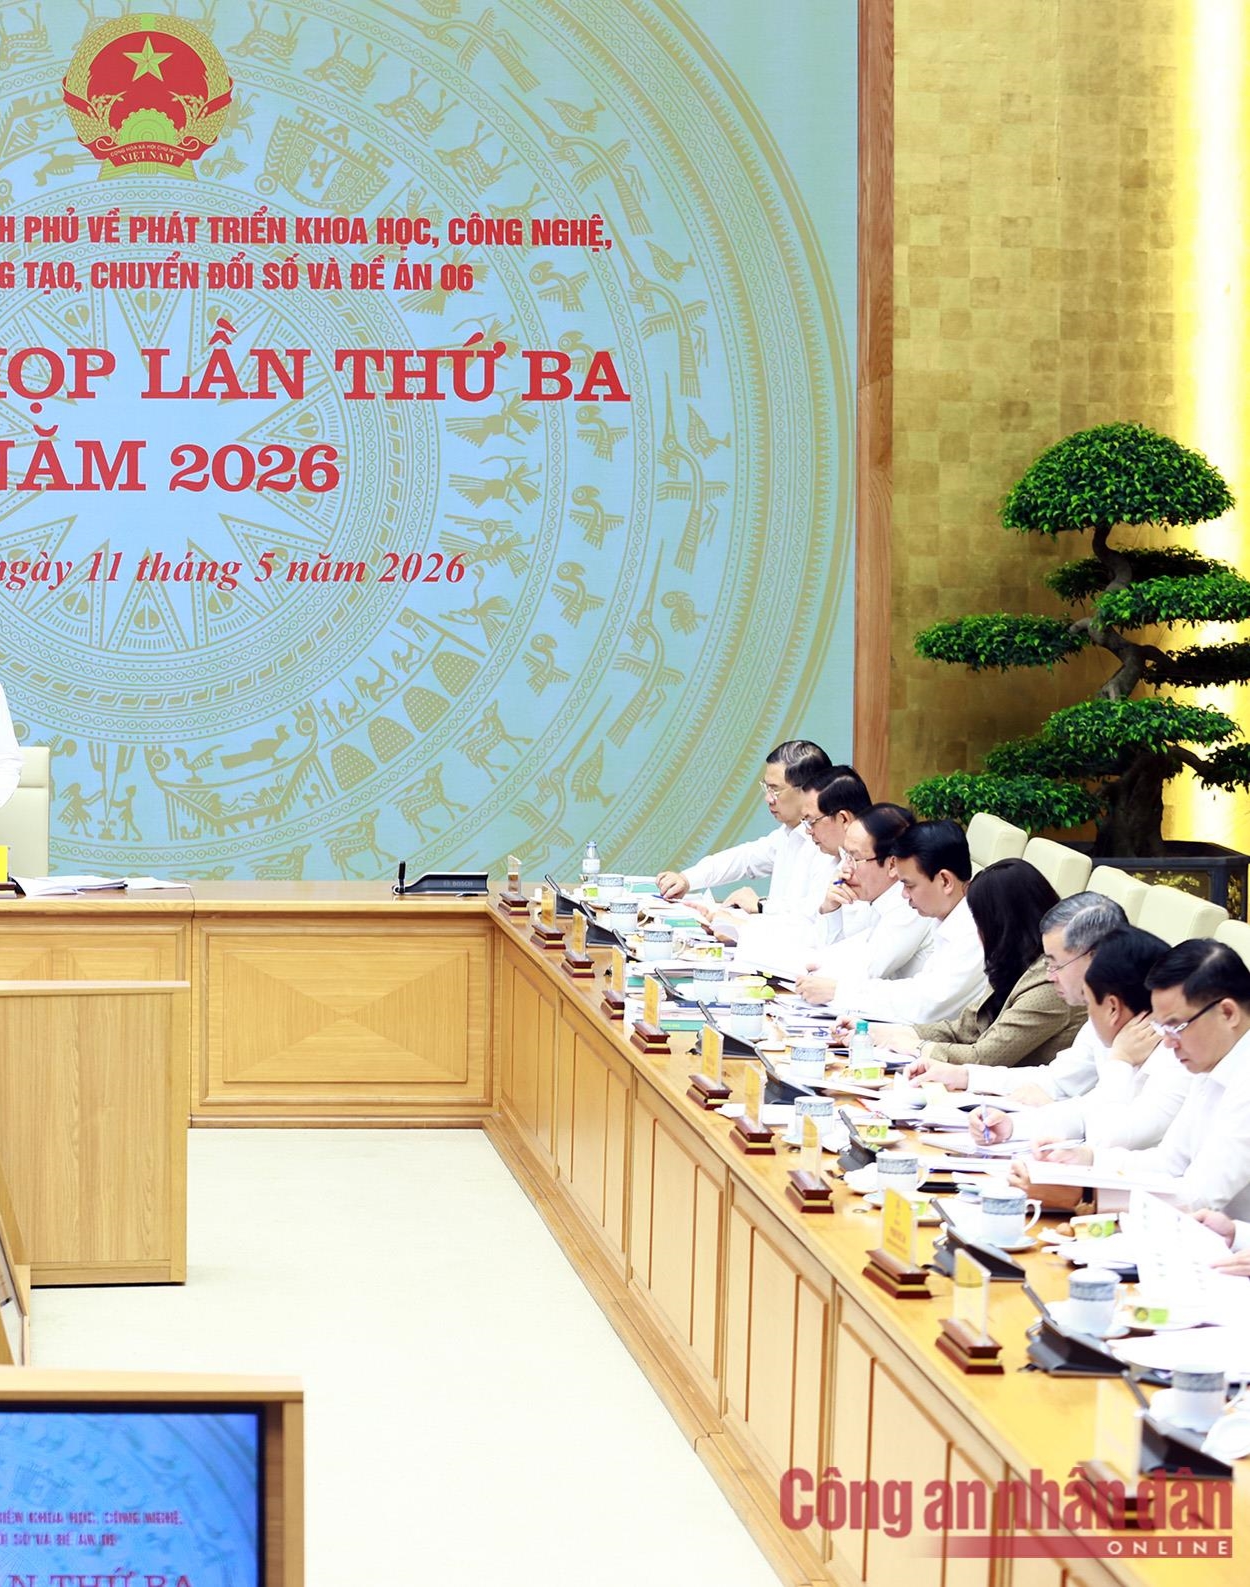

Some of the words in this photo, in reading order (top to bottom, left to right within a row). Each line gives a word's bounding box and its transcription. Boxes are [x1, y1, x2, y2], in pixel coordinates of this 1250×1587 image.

[121, 151, 146, 162] VIỆT
[150, 151, 174, 163] NAM
[24, 207, 79, 244] PHỦ
[88, 206, 120, 244] VỀ
[129, 210, 200, 245] PHÁT
[207, 205, 286, 245] TRIỂN
[295, 217, 368, 246] KHOA
[377, 217, 440, 251] HỌC,
[448, 211, 523, 247] CÔNG
[532, 213, 613, 253] NGHỆ,
[23, 262, 83, 295] TẠO,
[91, 250, 200, 290] CHUYỂN
[207, 250, 253, 290] ĐỔI
[263, 252, 299, 291] SỐ
[307, 257, 343, 290] VÀ
[350, 253, 385, 291] ĐỀ
[394, 257, 433, 291] ÁN
[441, 263, 474, 292] 06
[141, 317, 311, 401] LẦN
[335, 331, 507, 403] THỨ
[521, 350, 631, 403] BA
[169, 444, 341, 494] 2026
[88, 551, 123, 582] 11
[137, 548, 241, 591] tháng
[255, 552, 275, 583] 5
[286, 552, 367, 583] năm
[379, 552, 466, 584] 2026
